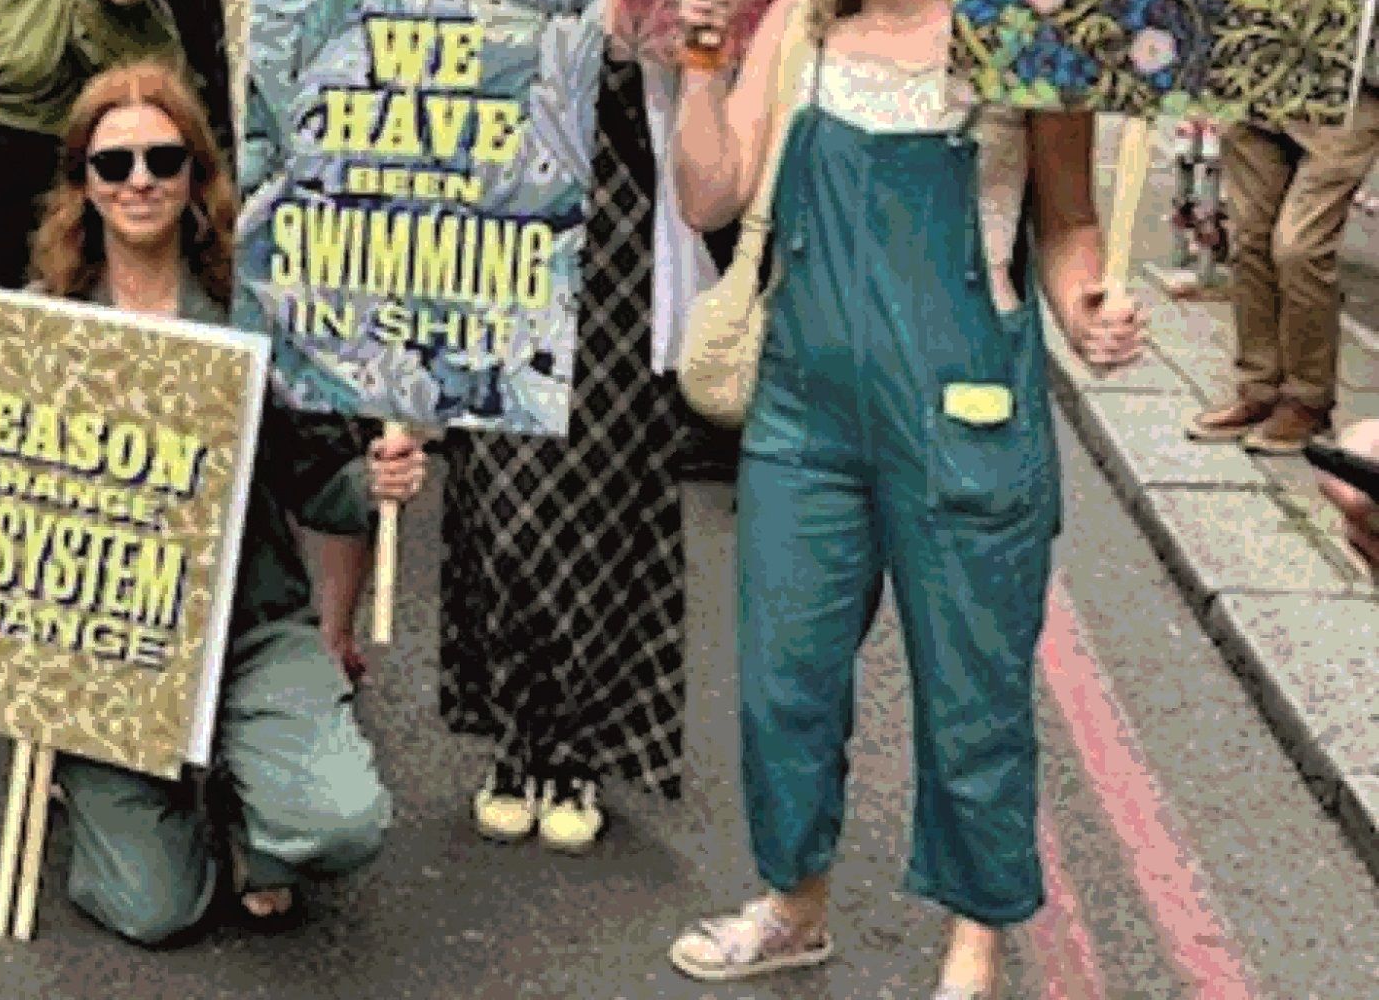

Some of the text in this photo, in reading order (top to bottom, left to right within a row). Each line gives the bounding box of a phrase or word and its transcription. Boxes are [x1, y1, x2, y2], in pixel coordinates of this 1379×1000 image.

[366, 17, 485, 87] WE
[321, 90, 526, 162] HAVE
[346, 166, 481, 202] BEEN
[270, 201, 554, 309] SWIMMING
[288, 302, 519, 351] IN SHIT
